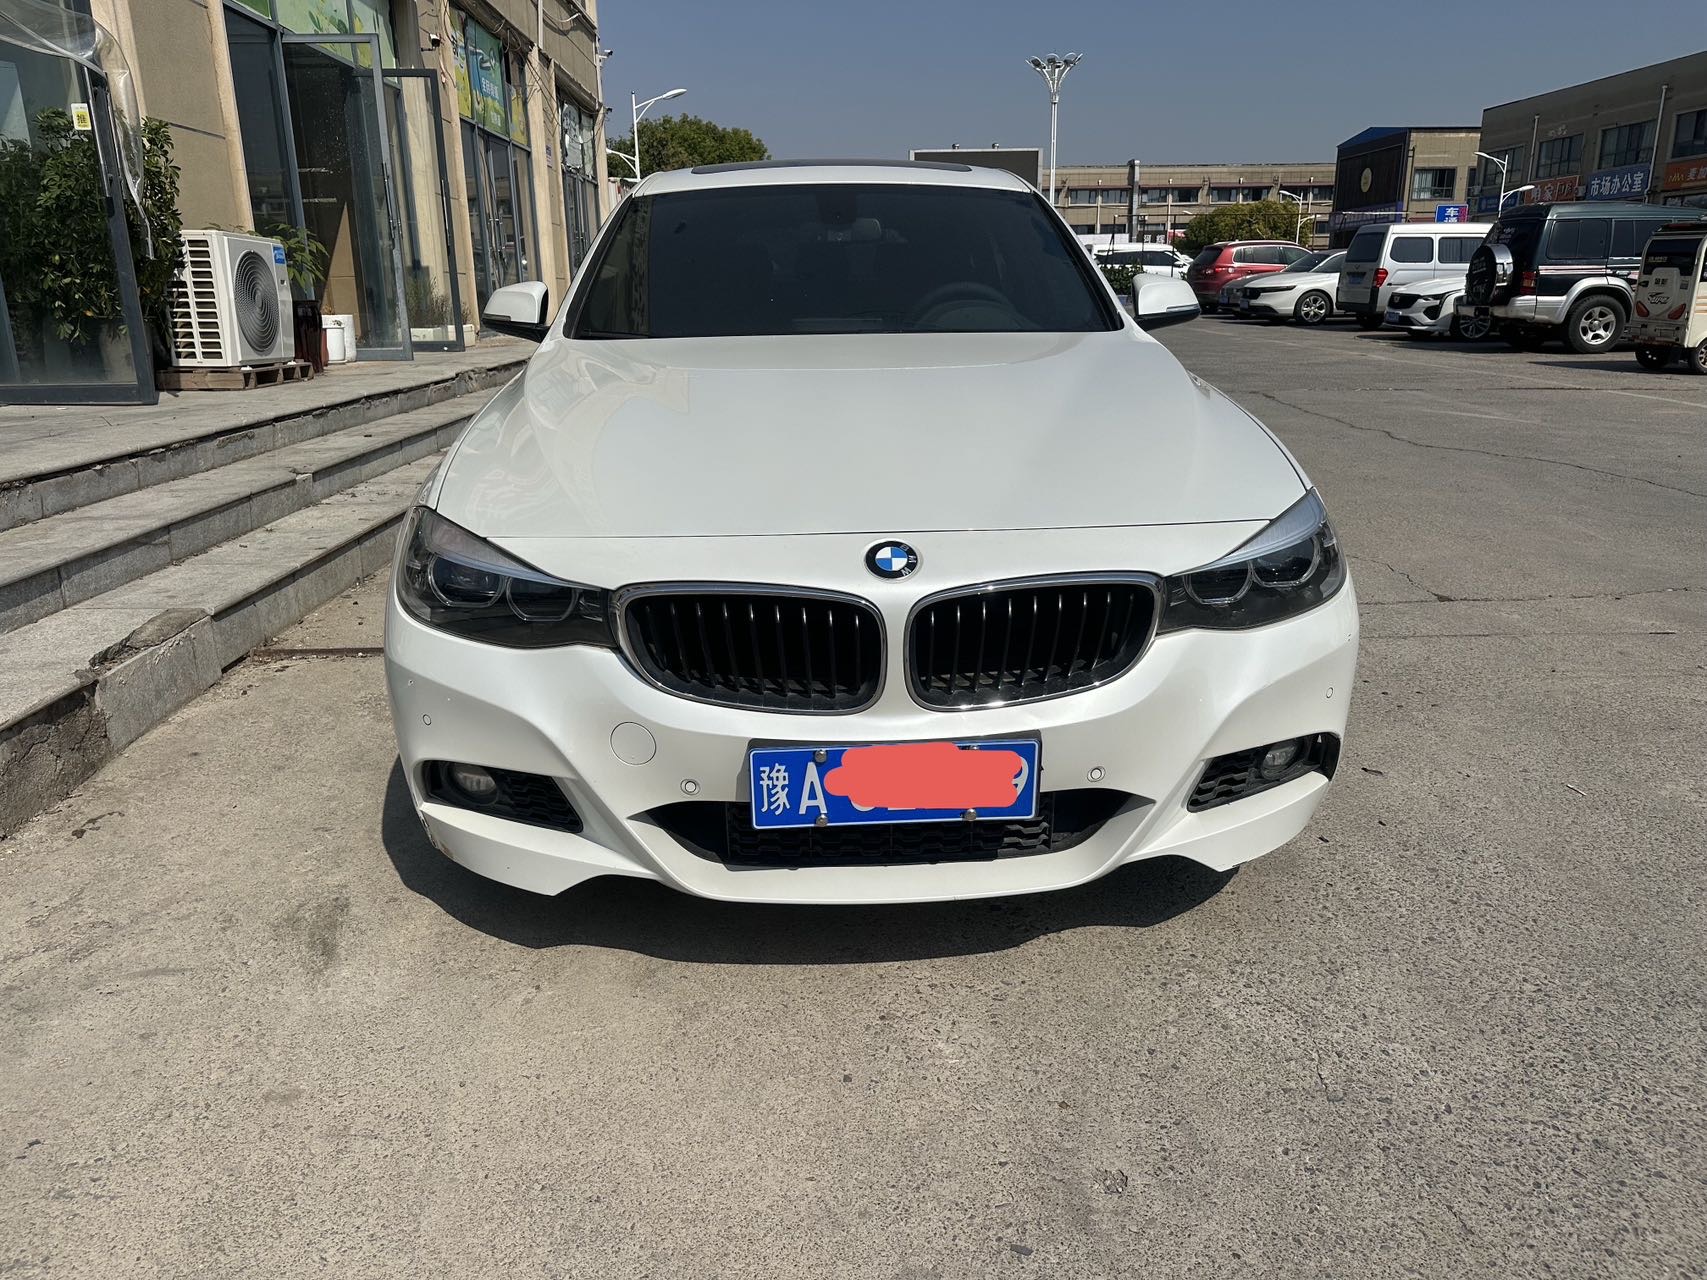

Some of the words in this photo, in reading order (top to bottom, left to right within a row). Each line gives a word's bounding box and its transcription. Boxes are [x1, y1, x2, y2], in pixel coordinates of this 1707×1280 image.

[1590, 171, 1644, 197] 市场办公室
[899, 543, 917, 577] BMW
